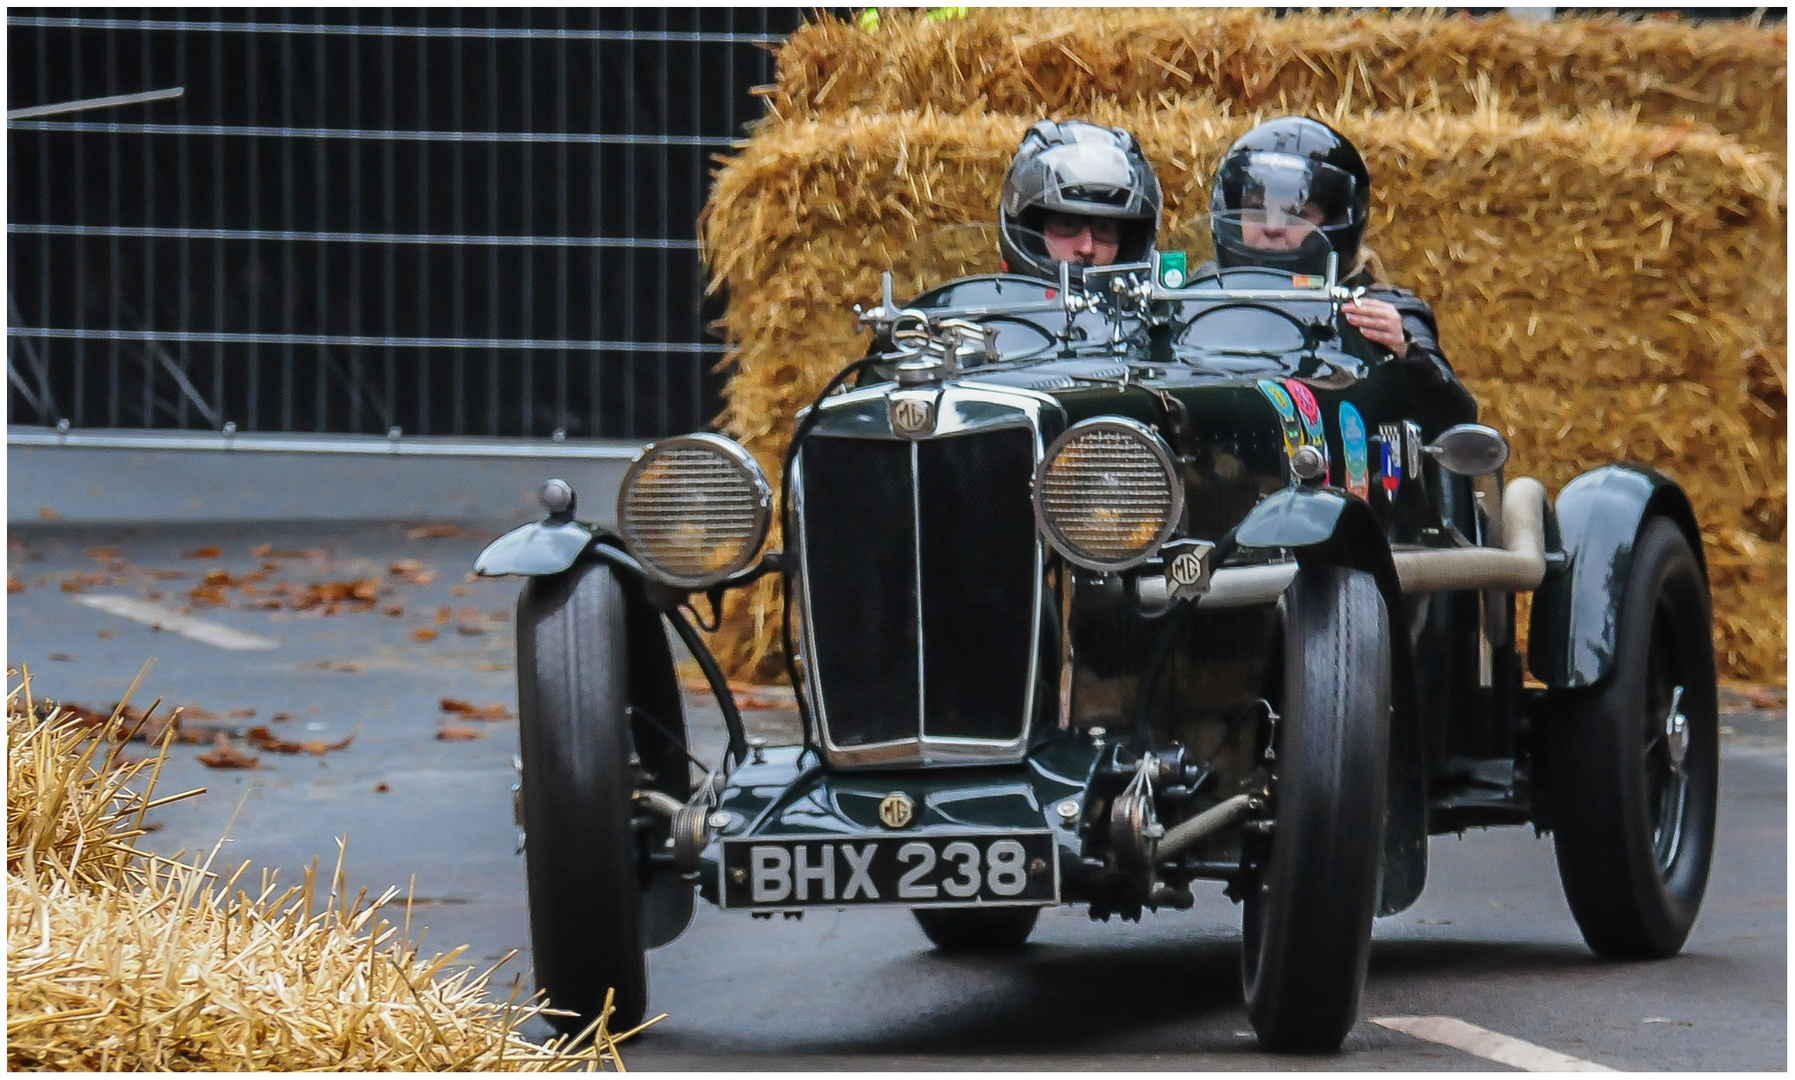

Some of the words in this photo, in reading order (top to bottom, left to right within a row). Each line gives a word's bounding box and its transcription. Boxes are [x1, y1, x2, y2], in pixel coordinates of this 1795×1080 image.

[898, 402, 925, 427] MG
[1174, 556, 1199, 582] MG
[883, 799, 910, 823] MG
[751, 843, 880, 902] BHX
[896, 839, 1027, 898] 238
